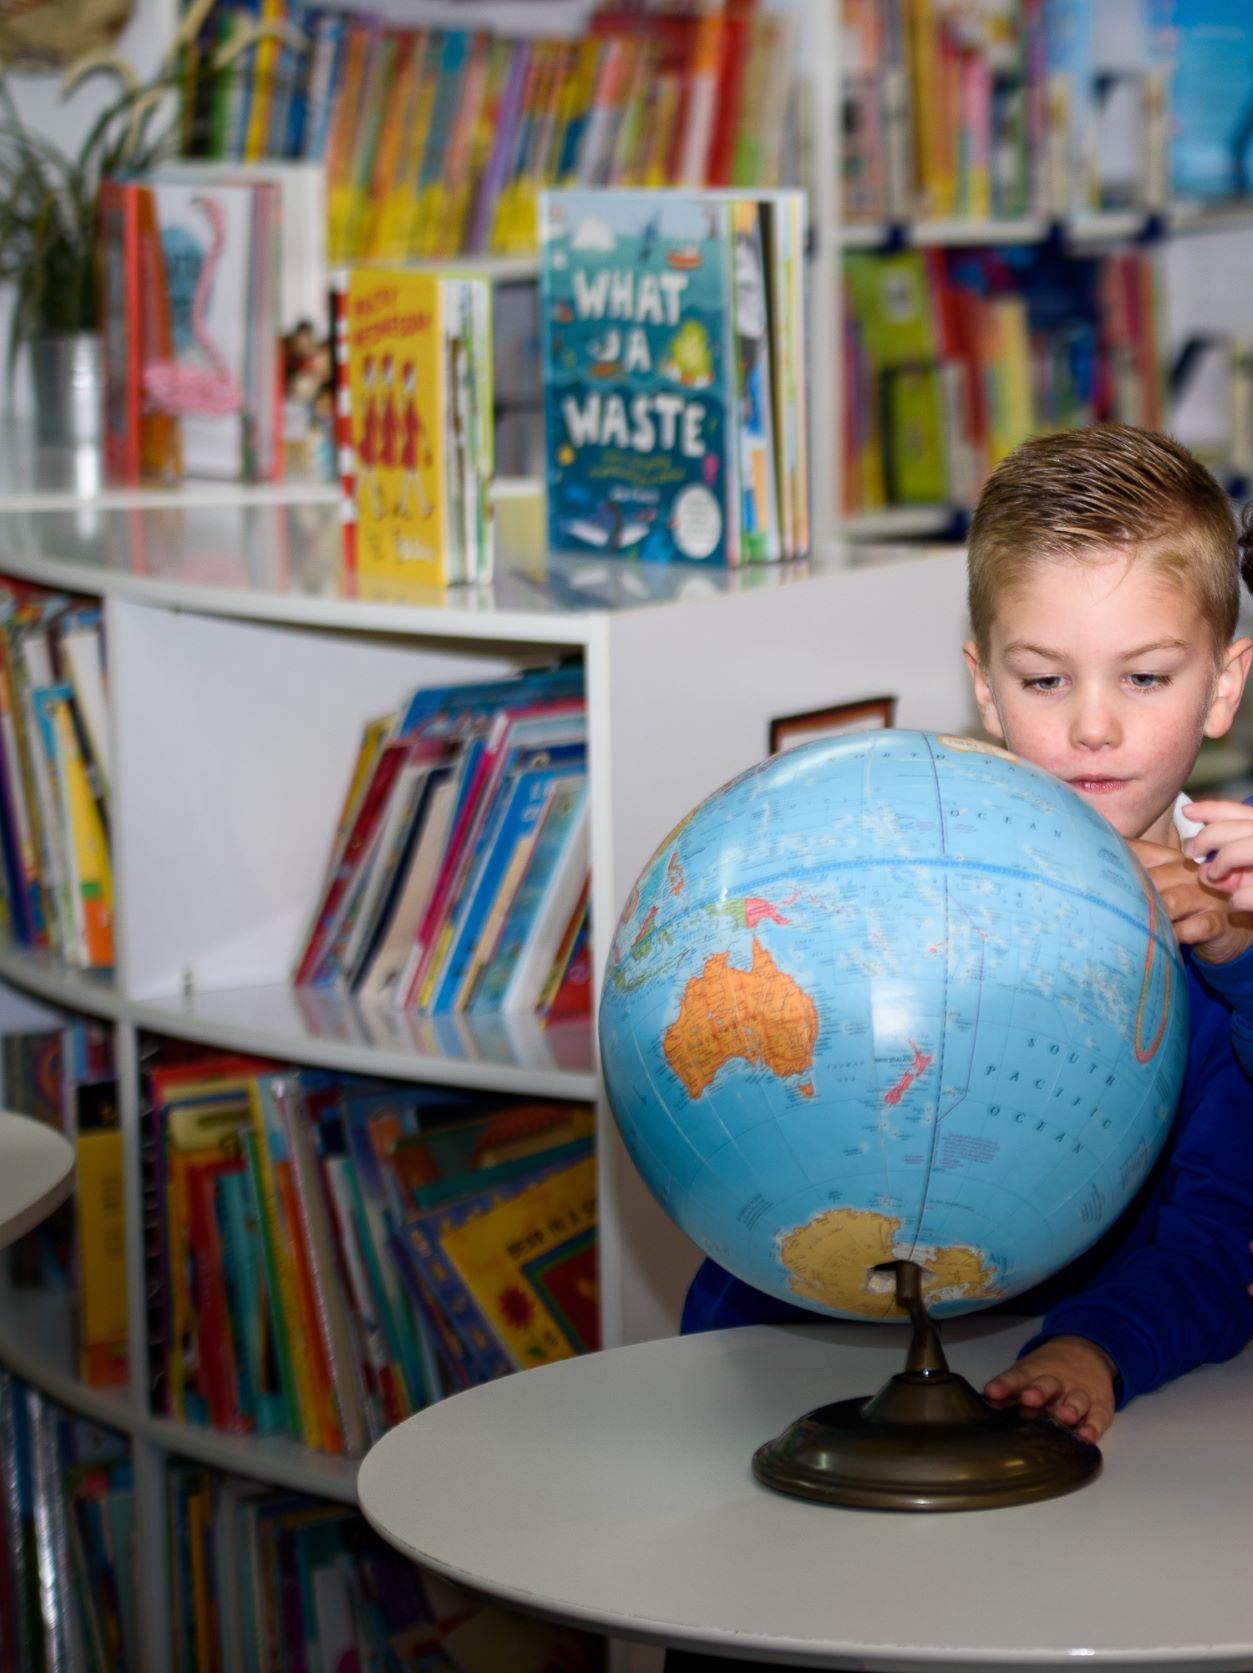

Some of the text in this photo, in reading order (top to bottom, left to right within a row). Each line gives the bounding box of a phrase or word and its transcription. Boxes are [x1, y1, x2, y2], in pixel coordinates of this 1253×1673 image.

[572, 267, 688, 326] WHAT
[625, 327, 651, 373] A
[563, 391, 706, 457] WASTE
[1026, 1036, 1117, 1088] SOUTH
[985, 1063, 1113, 1129] PACIFIC
[988, 1103, 1084, 1154] OCEAN
